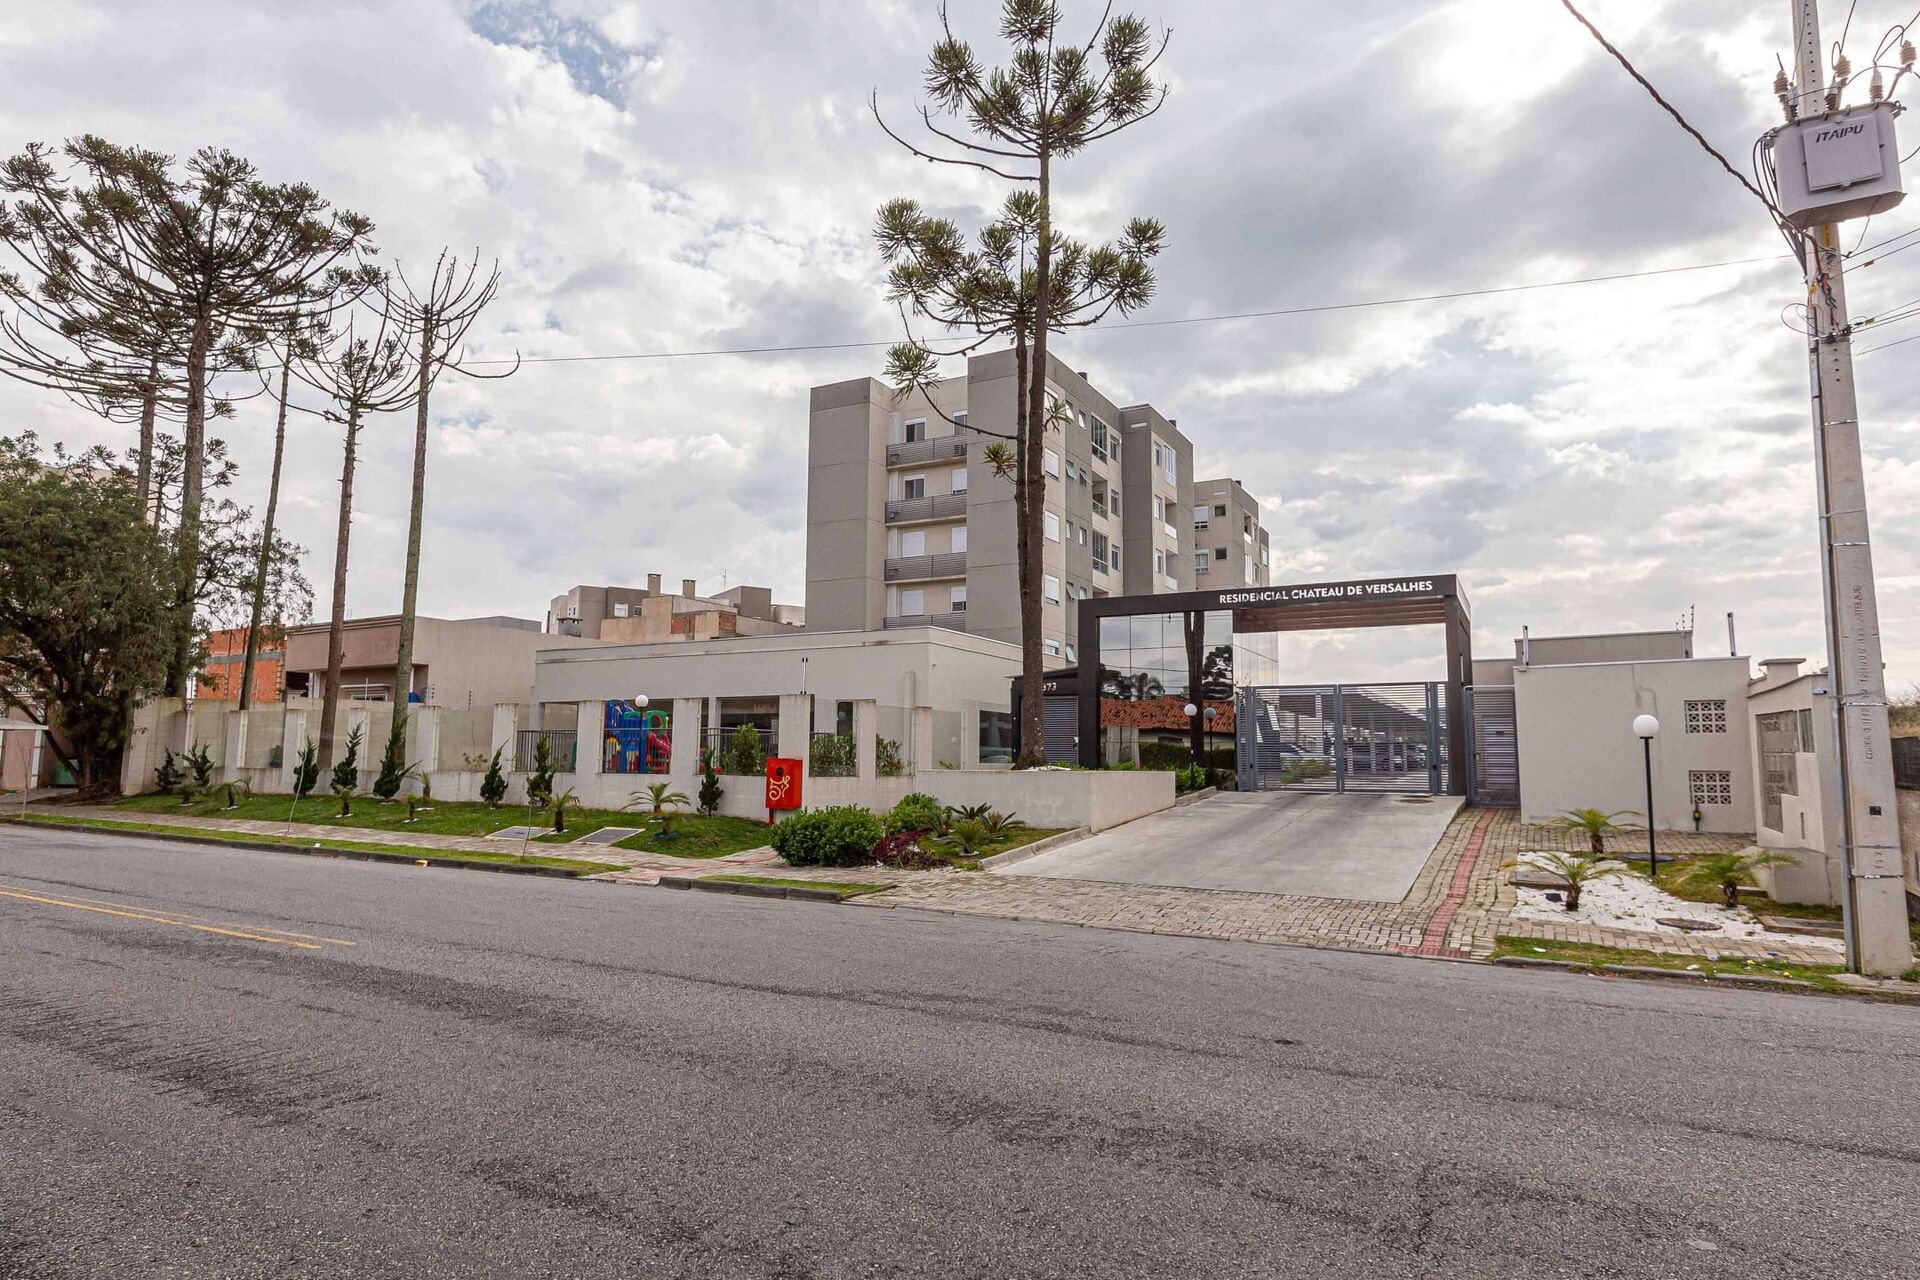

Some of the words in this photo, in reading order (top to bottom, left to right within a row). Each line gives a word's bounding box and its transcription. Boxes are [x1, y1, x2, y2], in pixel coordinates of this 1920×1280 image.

[1816, 124, 1864, 143] ITAIPU
[1219, 591, 1289, 604] RESIDENCIAL
[1291, 586, 1344, 599] CHATEAU
[1347, 585, 1363, 596] DE
[1365, 581, 1433, 594] VERSALHES
